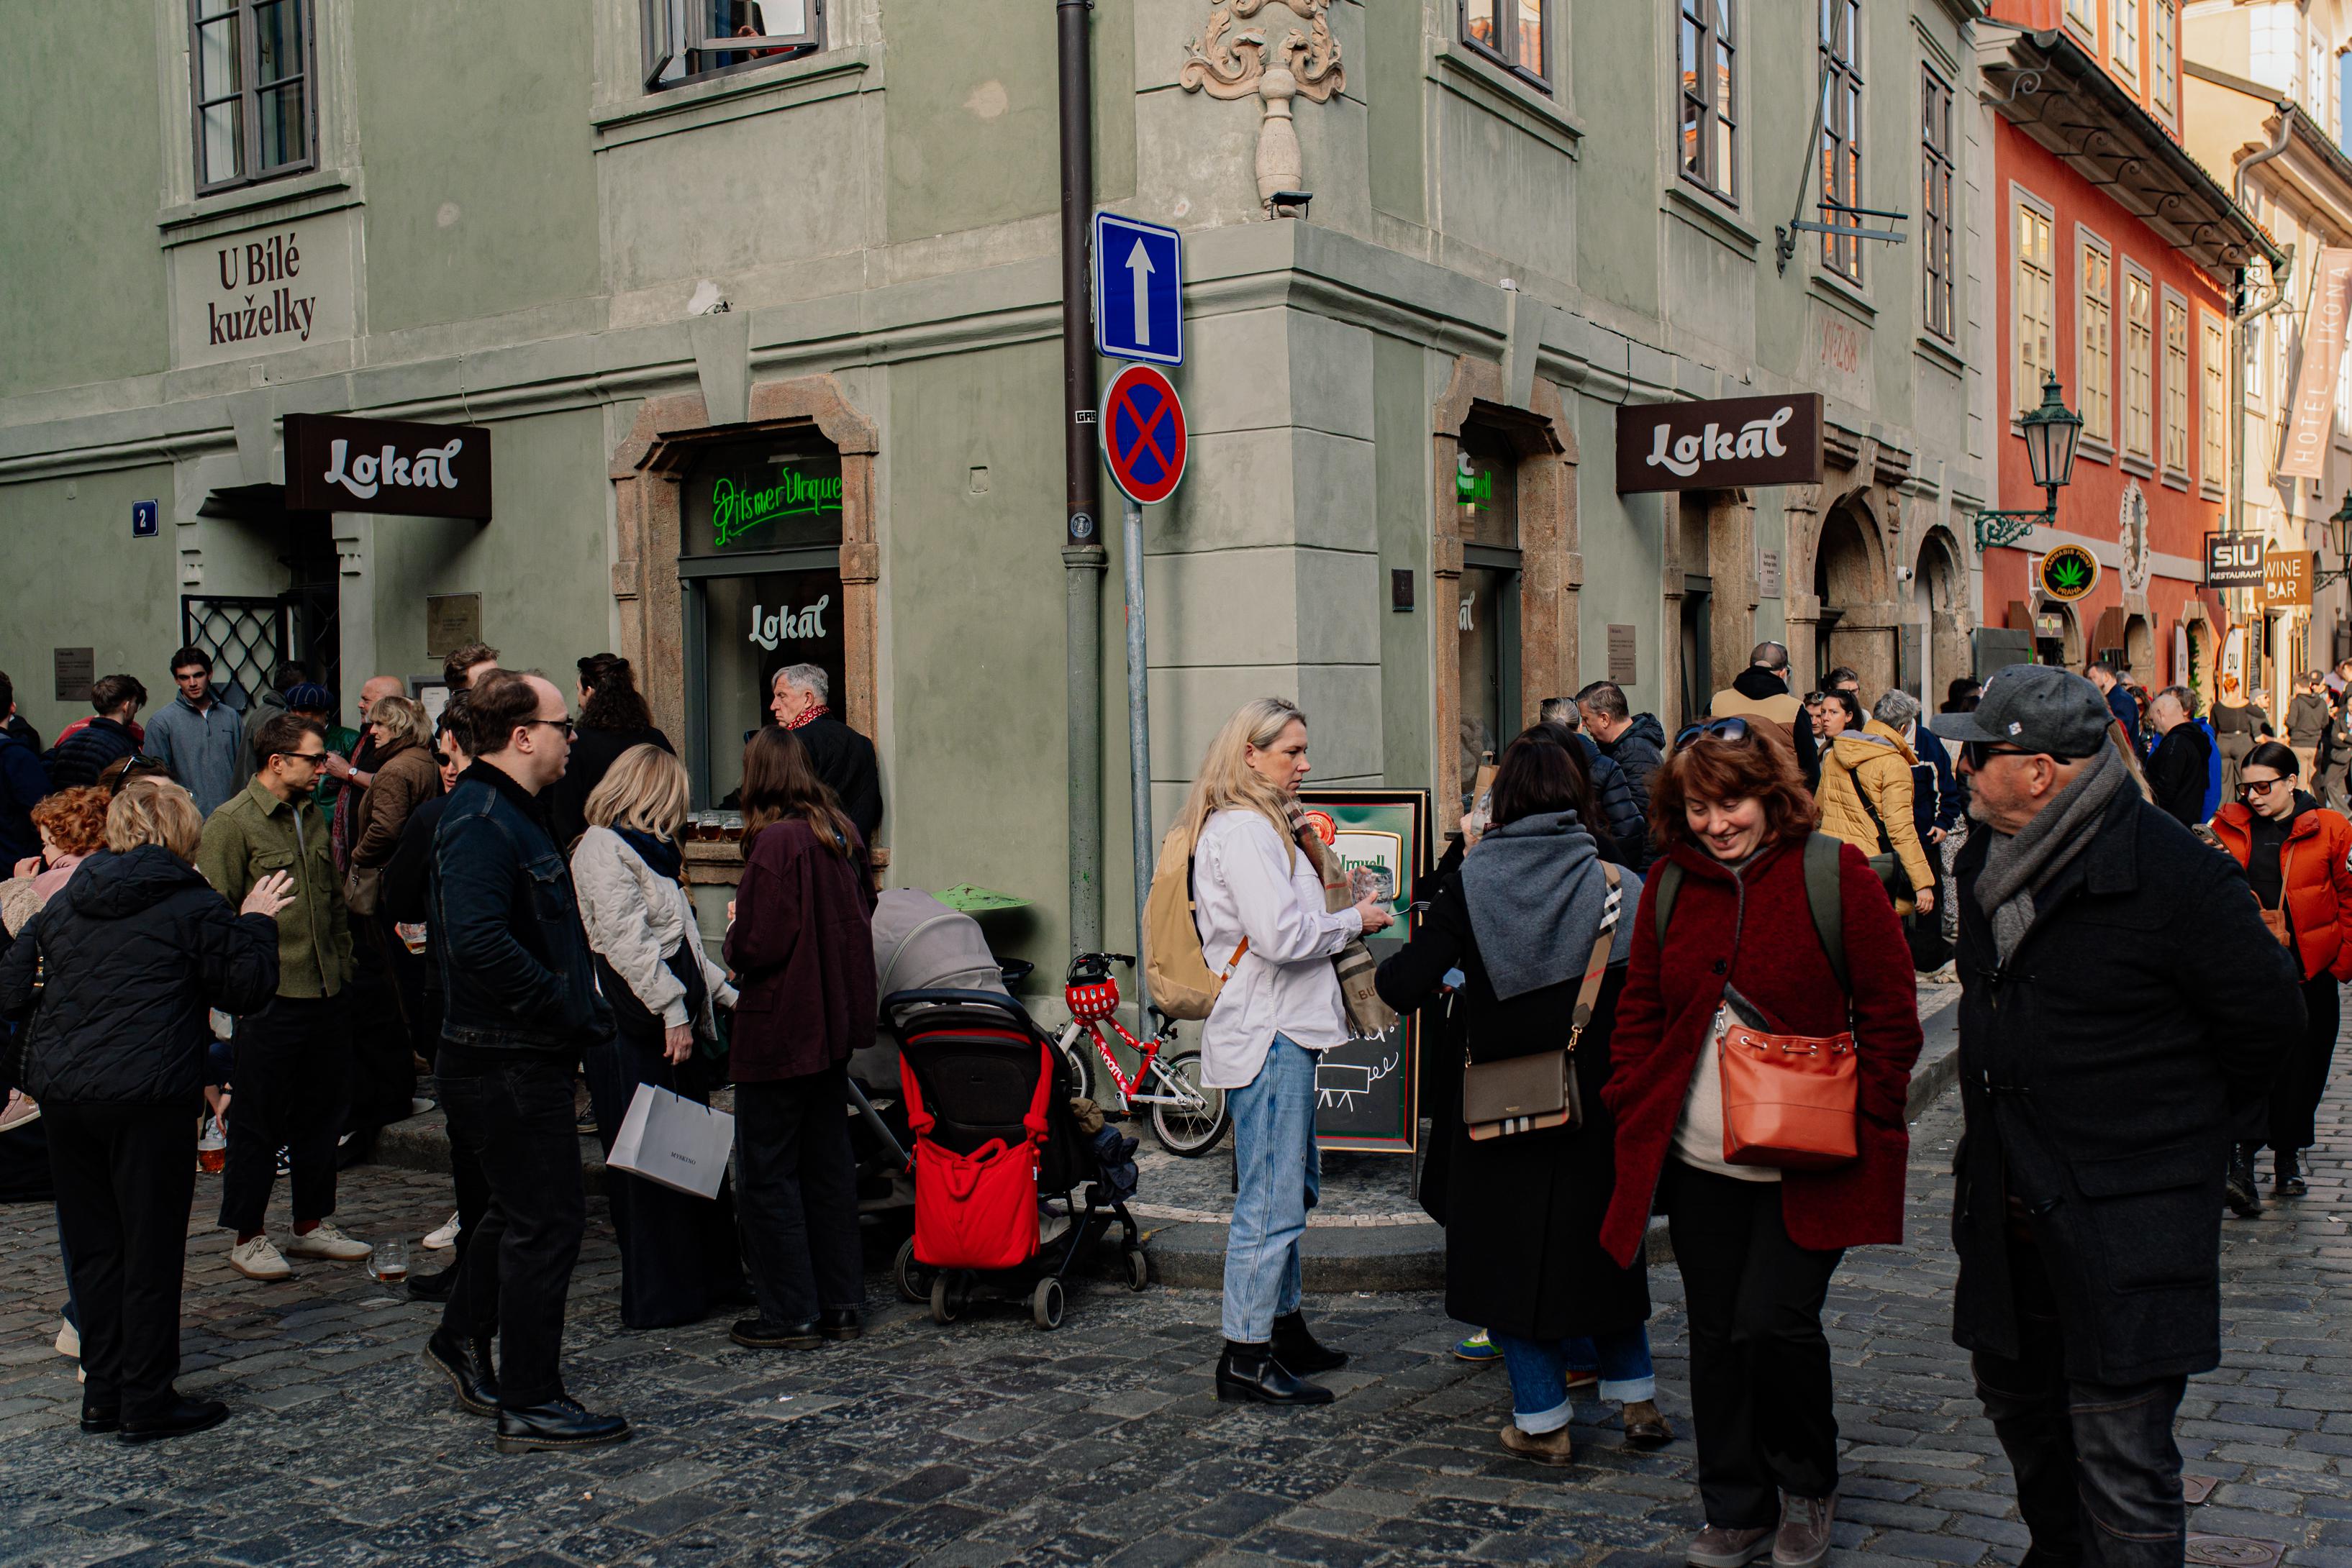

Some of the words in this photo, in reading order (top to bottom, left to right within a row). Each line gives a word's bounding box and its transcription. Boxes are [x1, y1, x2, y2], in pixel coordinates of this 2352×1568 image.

[218, 247, 238, 290] U
[245, 232, 300, 286] Bílé
[208, 288, 316, 346] kuželky
[2294, 385, 2329, 463] HOTEL
[2317, 266, 2351, 345] IKONA
[783, 468, 843, 516] Urque
[139, 509, 147, 528] 2
[2045, 549, 2075, 572] CANNABIS
[2214, 544, 2260, 568] SIU
[2210, 570, 2263, 580] RESTAURANT
[2264, 559, 2302, 579] WINE
[2056, 585, 2082, 596] PRAHA
[2267, 580, 2297, 600] BAR
[2228, 652, 2238, 670] SIU
